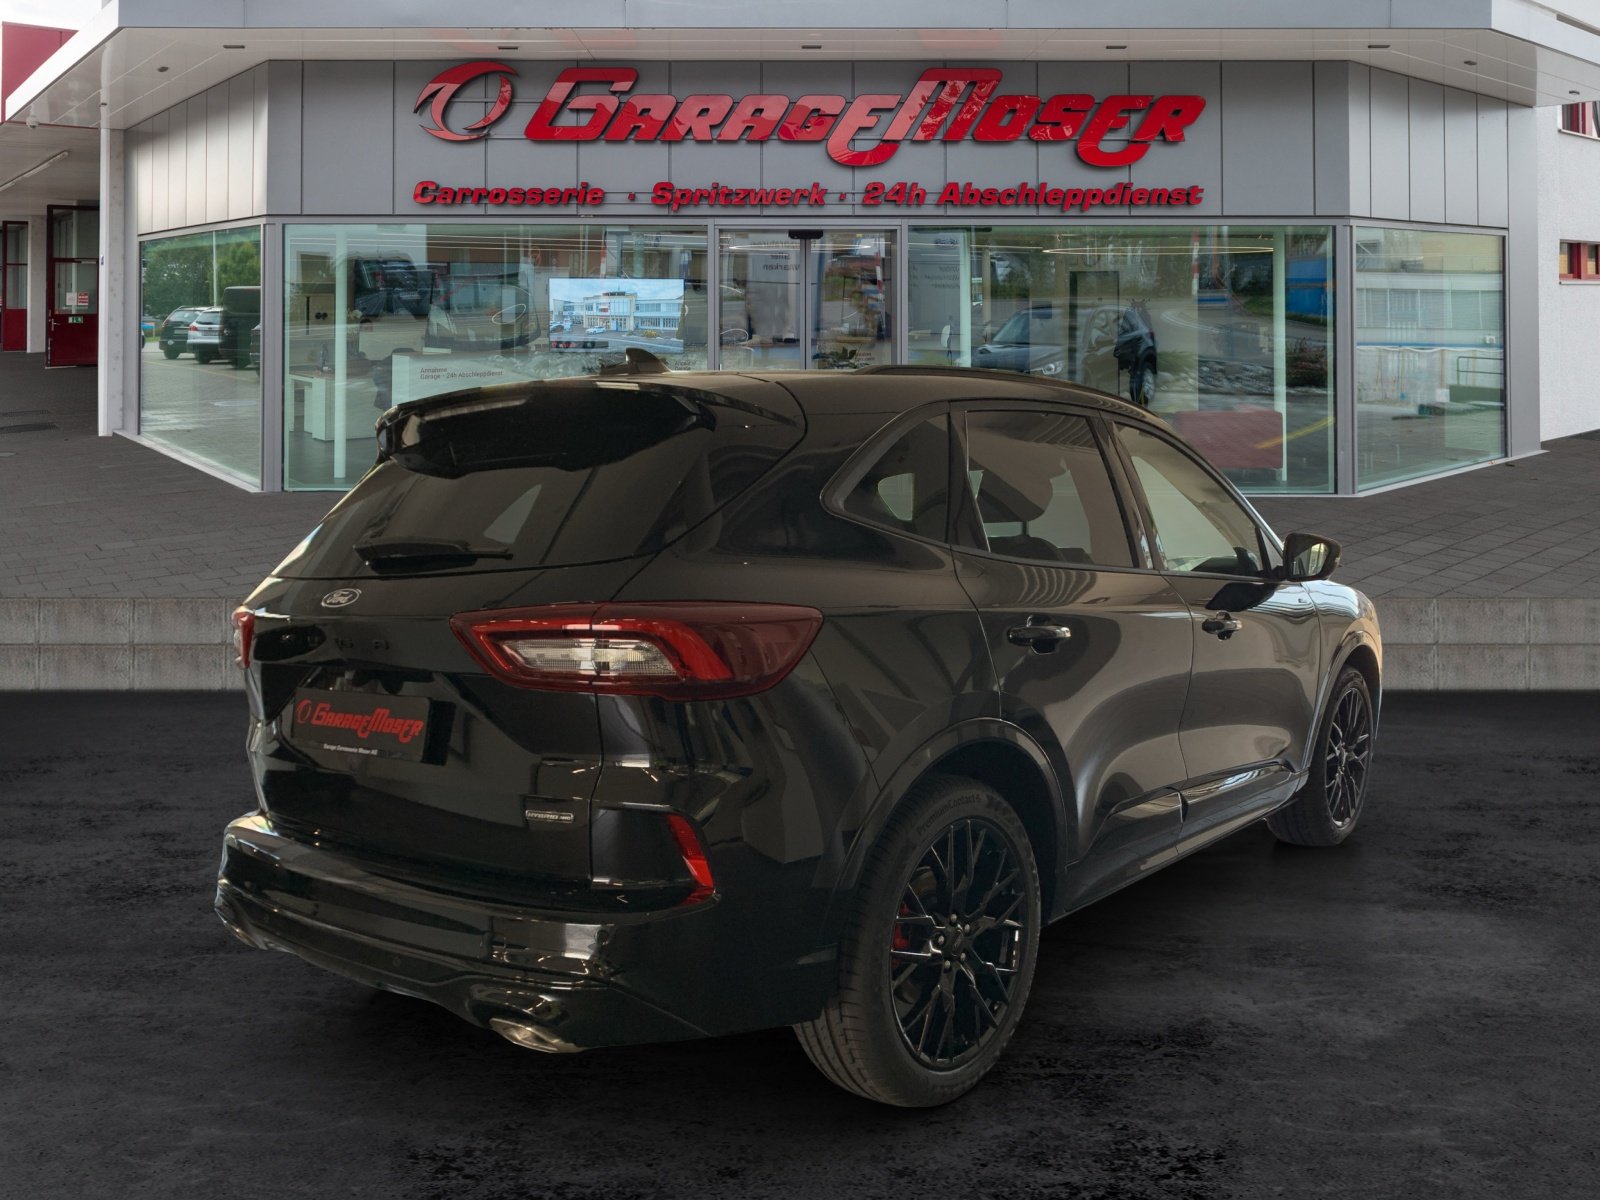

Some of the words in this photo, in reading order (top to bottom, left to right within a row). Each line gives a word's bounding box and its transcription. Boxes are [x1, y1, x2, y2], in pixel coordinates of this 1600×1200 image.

[412, 180, 605, 205] Carrosserie
[650, 181, 827, 211] Spritzwerk
[862, 181, 927, 206] 24h
[936, 181, 1204, 212] Abschleppdienst
